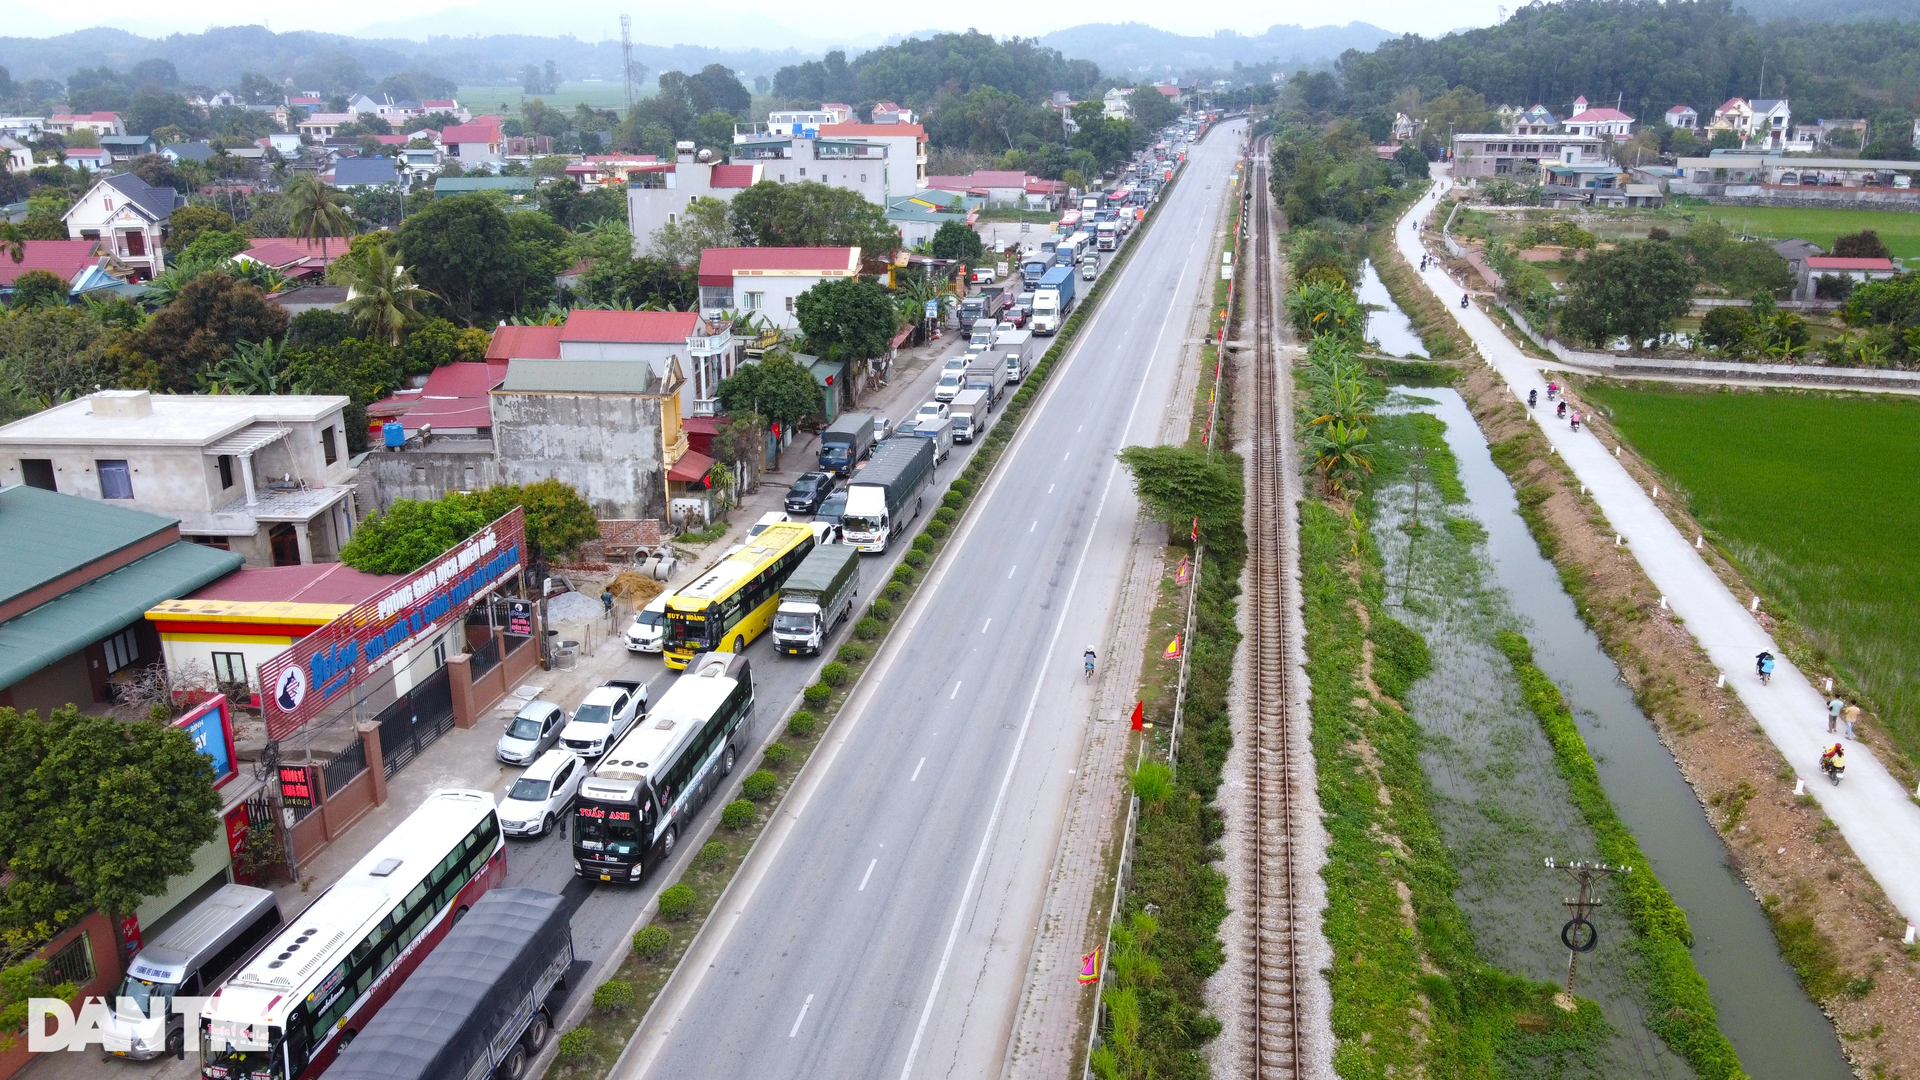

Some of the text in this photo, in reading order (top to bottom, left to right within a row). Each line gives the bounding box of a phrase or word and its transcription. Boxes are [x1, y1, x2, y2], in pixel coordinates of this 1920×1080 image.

[378, 590, 413, 620] PHÒNG
[413, 571, 436, 598] GIAO
[436, 557, 458, 586] DỊCH
[458, 539, 480, 571] MIỀN
[480, 527, 496, 556] BẮC
[580, 806, 630, 820] TUẤN ANH
